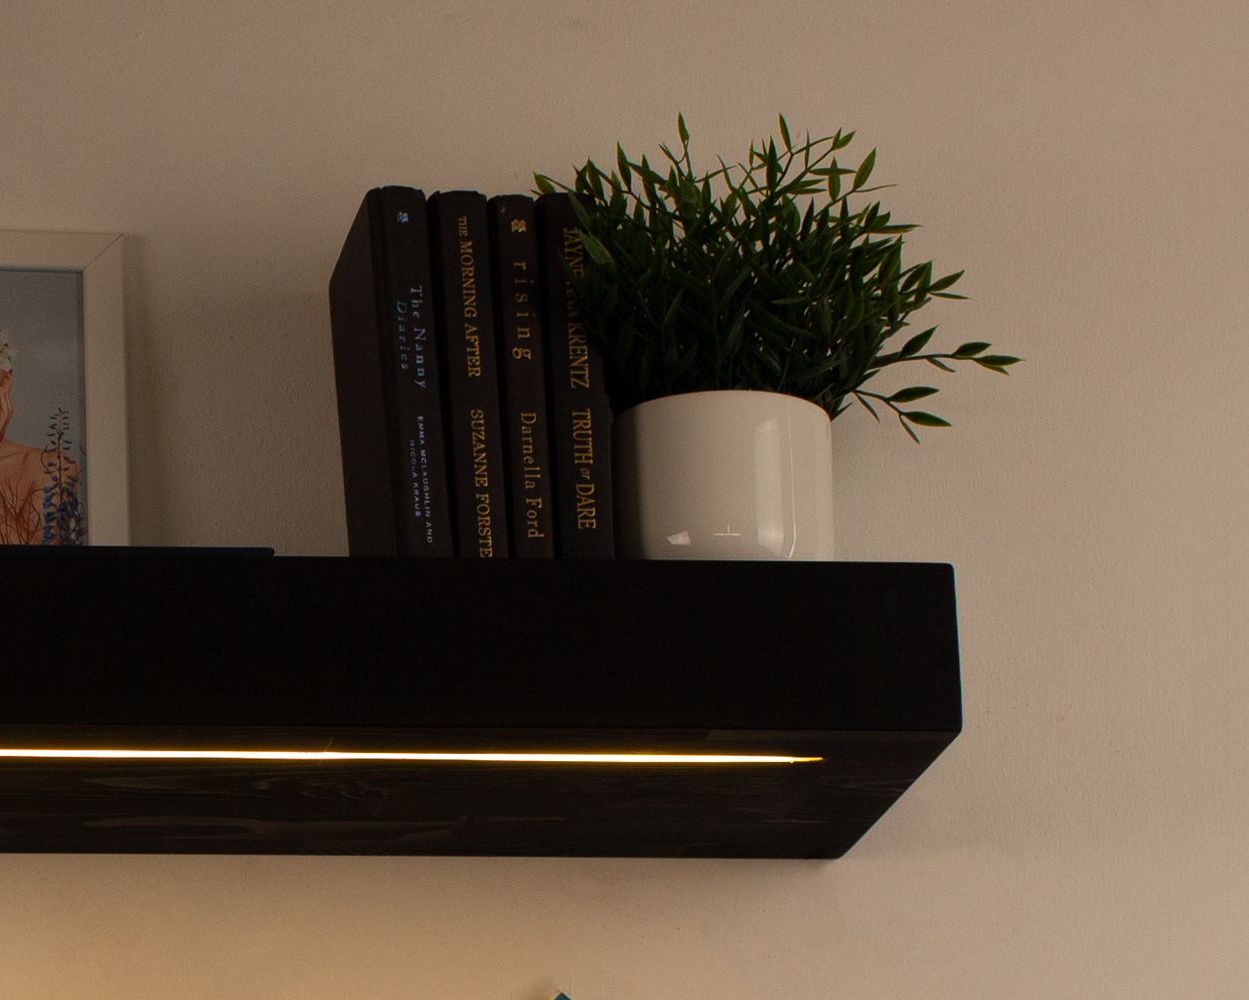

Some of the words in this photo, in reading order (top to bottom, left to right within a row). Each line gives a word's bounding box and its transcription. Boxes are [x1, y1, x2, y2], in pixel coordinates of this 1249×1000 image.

[457, 216, 469, 237] THE
[410, 284, 423, 319] The
[459, 241, 479, 319] MORNING
[396, 299, 410, 371] Diaries
[511, 260, 534, 360] rising
[413, 326, 428, 390] Nanny
[464, 322, 482, 378] AFTER
[567, 320, 590, 389] KRENTZ
[408, 439, 418, 479] NICOLA
[470, 408, 489, 488] SUZANNE
[520, 411, 541, 490] Darnella
[571, 408, 594, 465] TRUTH
[412, 482, 422, 518] KRAUS
[415, 415, 425, 446] EMMA
[425, 521, 434, 544] AND
[579, 467, 592, 480] or
[525, 497, 545, 540] Ford
[575, 483, 597, 530] DARE
